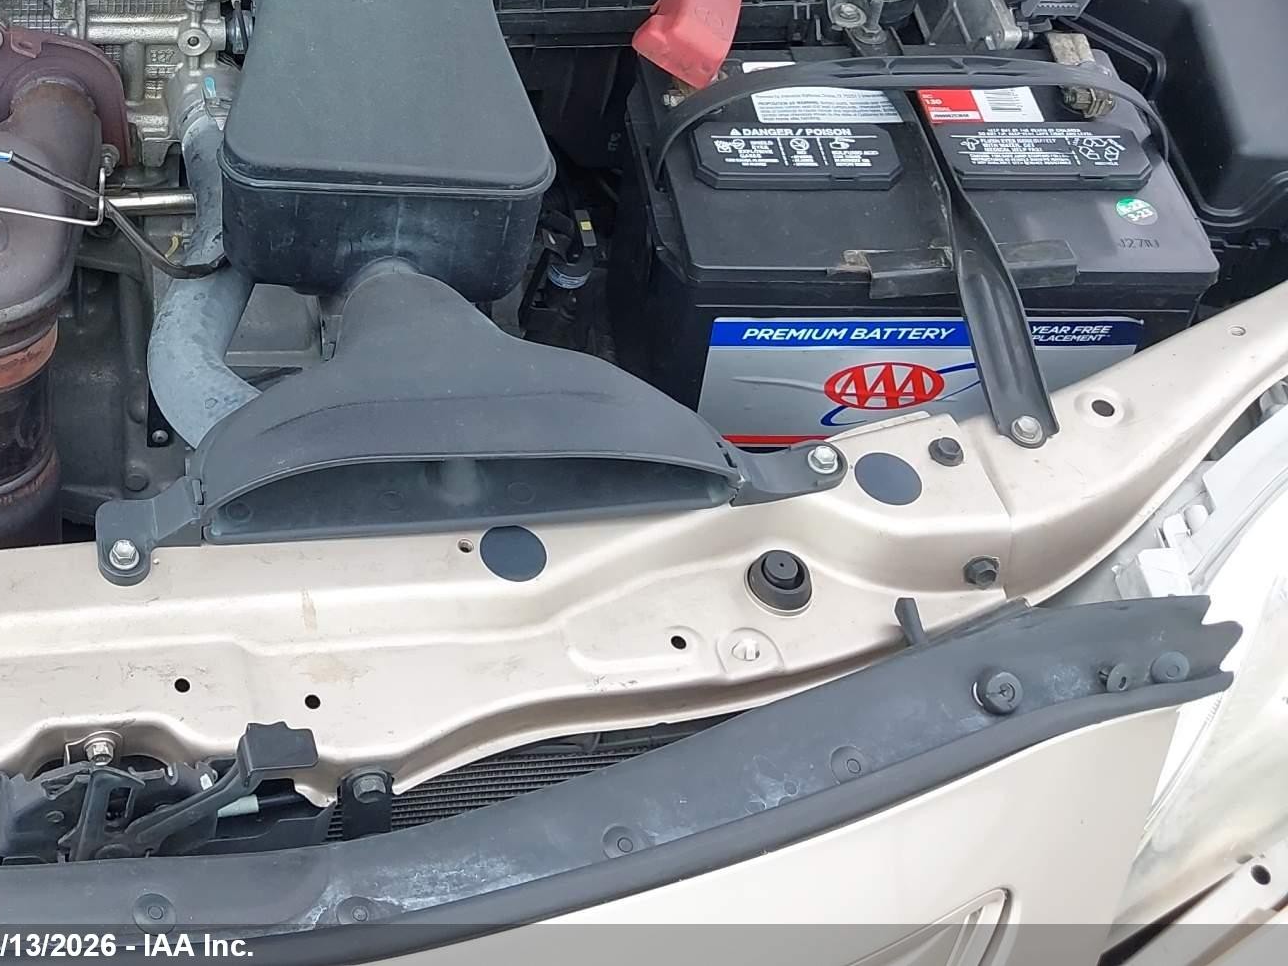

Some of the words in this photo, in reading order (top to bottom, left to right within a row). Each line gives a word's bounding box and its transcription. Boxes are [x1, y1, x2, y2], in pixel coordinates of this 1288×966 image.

[742, 128, 794, 136] DANGER
[805, 128, 852, 136] POISON
[743, 327, 845, 342] PREMIUM
[848, 326, 955, 341] BATTERY
[1031, 325, 1071, 334] YEAR
[1071, 325, 1113, 334] FREE
[1031, 334, 1106, 342] PLACEMENT
[834, 363, 934, 408] AAA
